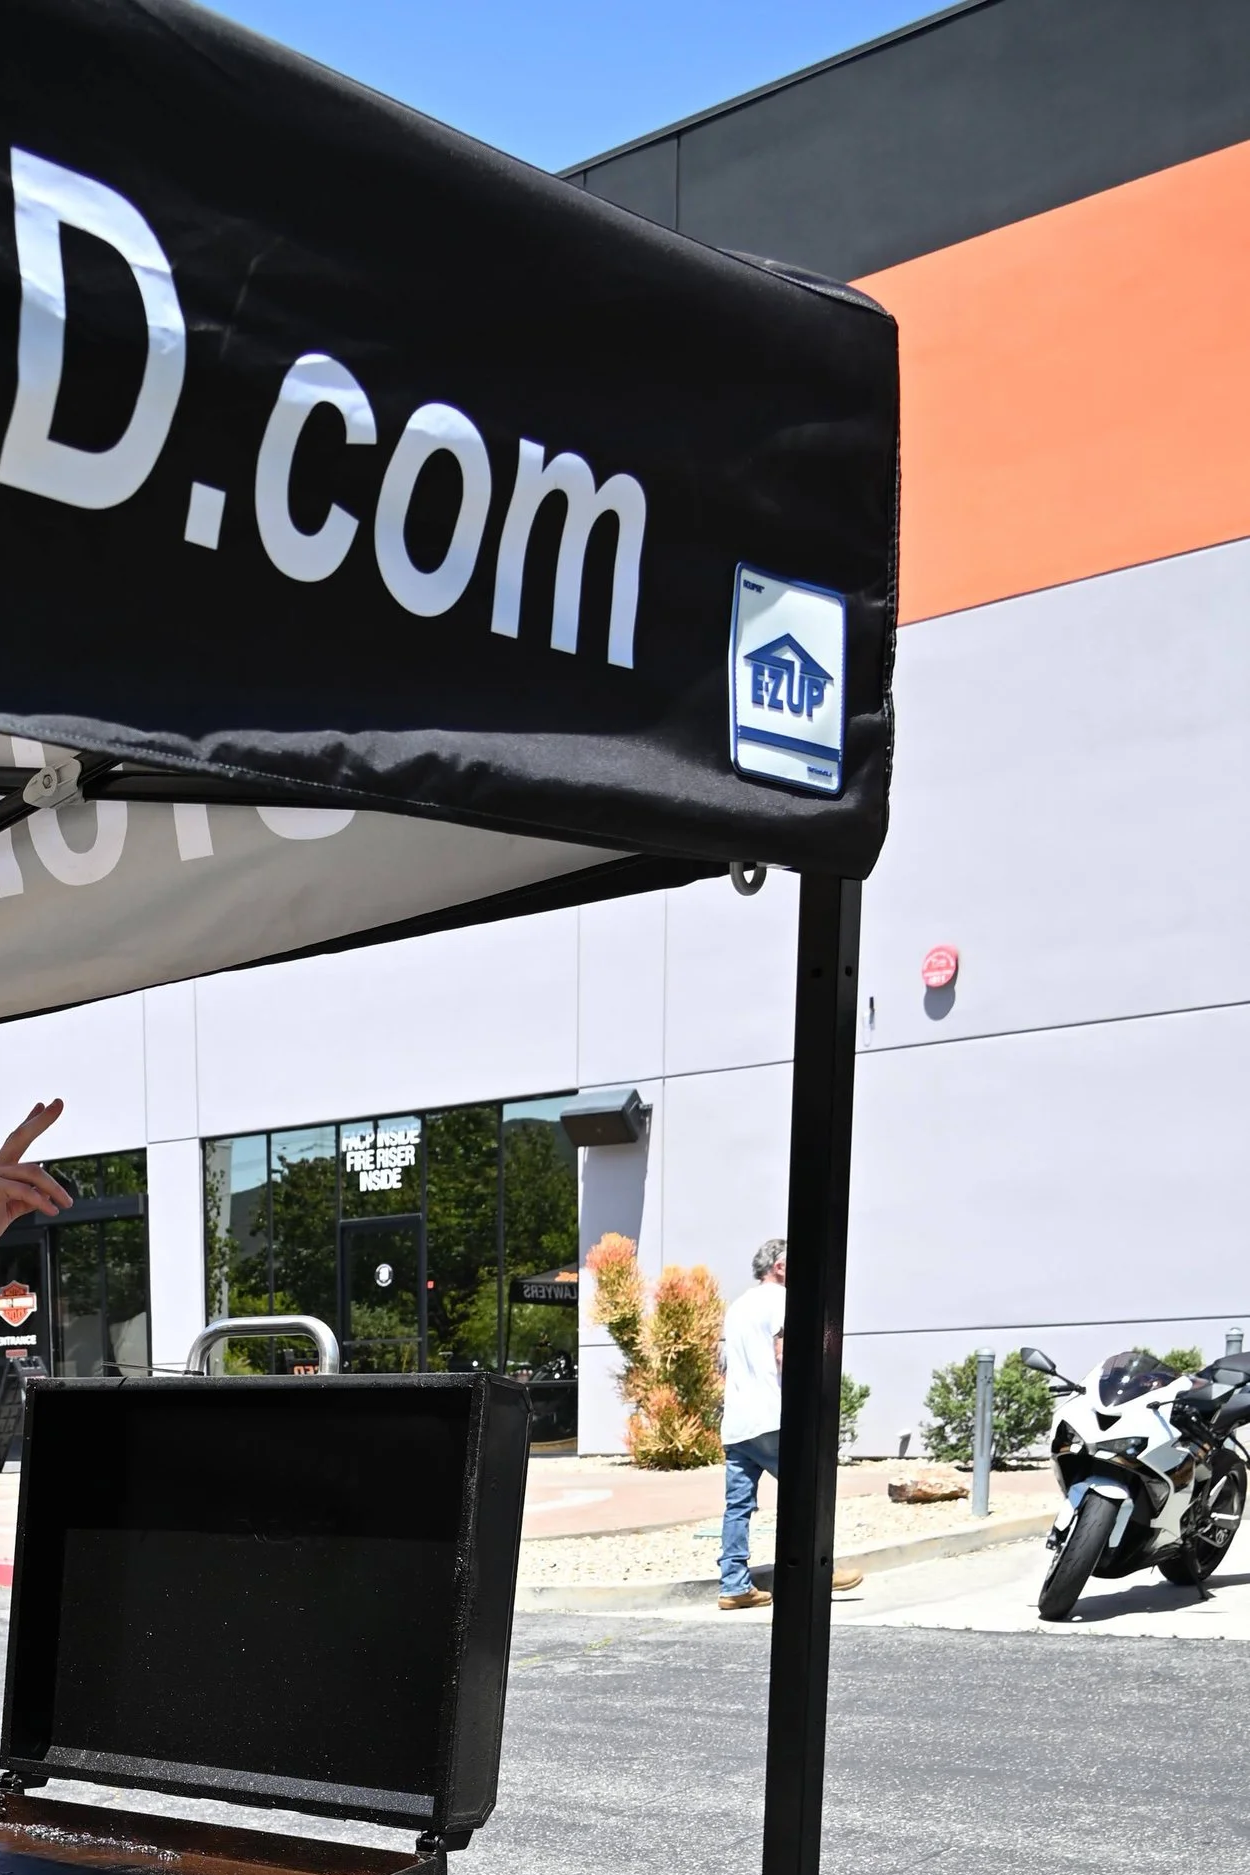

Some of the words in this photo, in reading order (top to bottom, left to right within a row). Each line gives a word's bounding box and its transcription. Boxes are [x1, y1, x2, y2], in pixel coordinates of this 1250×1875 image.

[377, 1123, 421, 1148] INSIDE
[346, 1149, 375, 1172] FIRE
[376, 1145, 416, 1169] RISER
[359, 1168, 402, 1192] INSIDE
